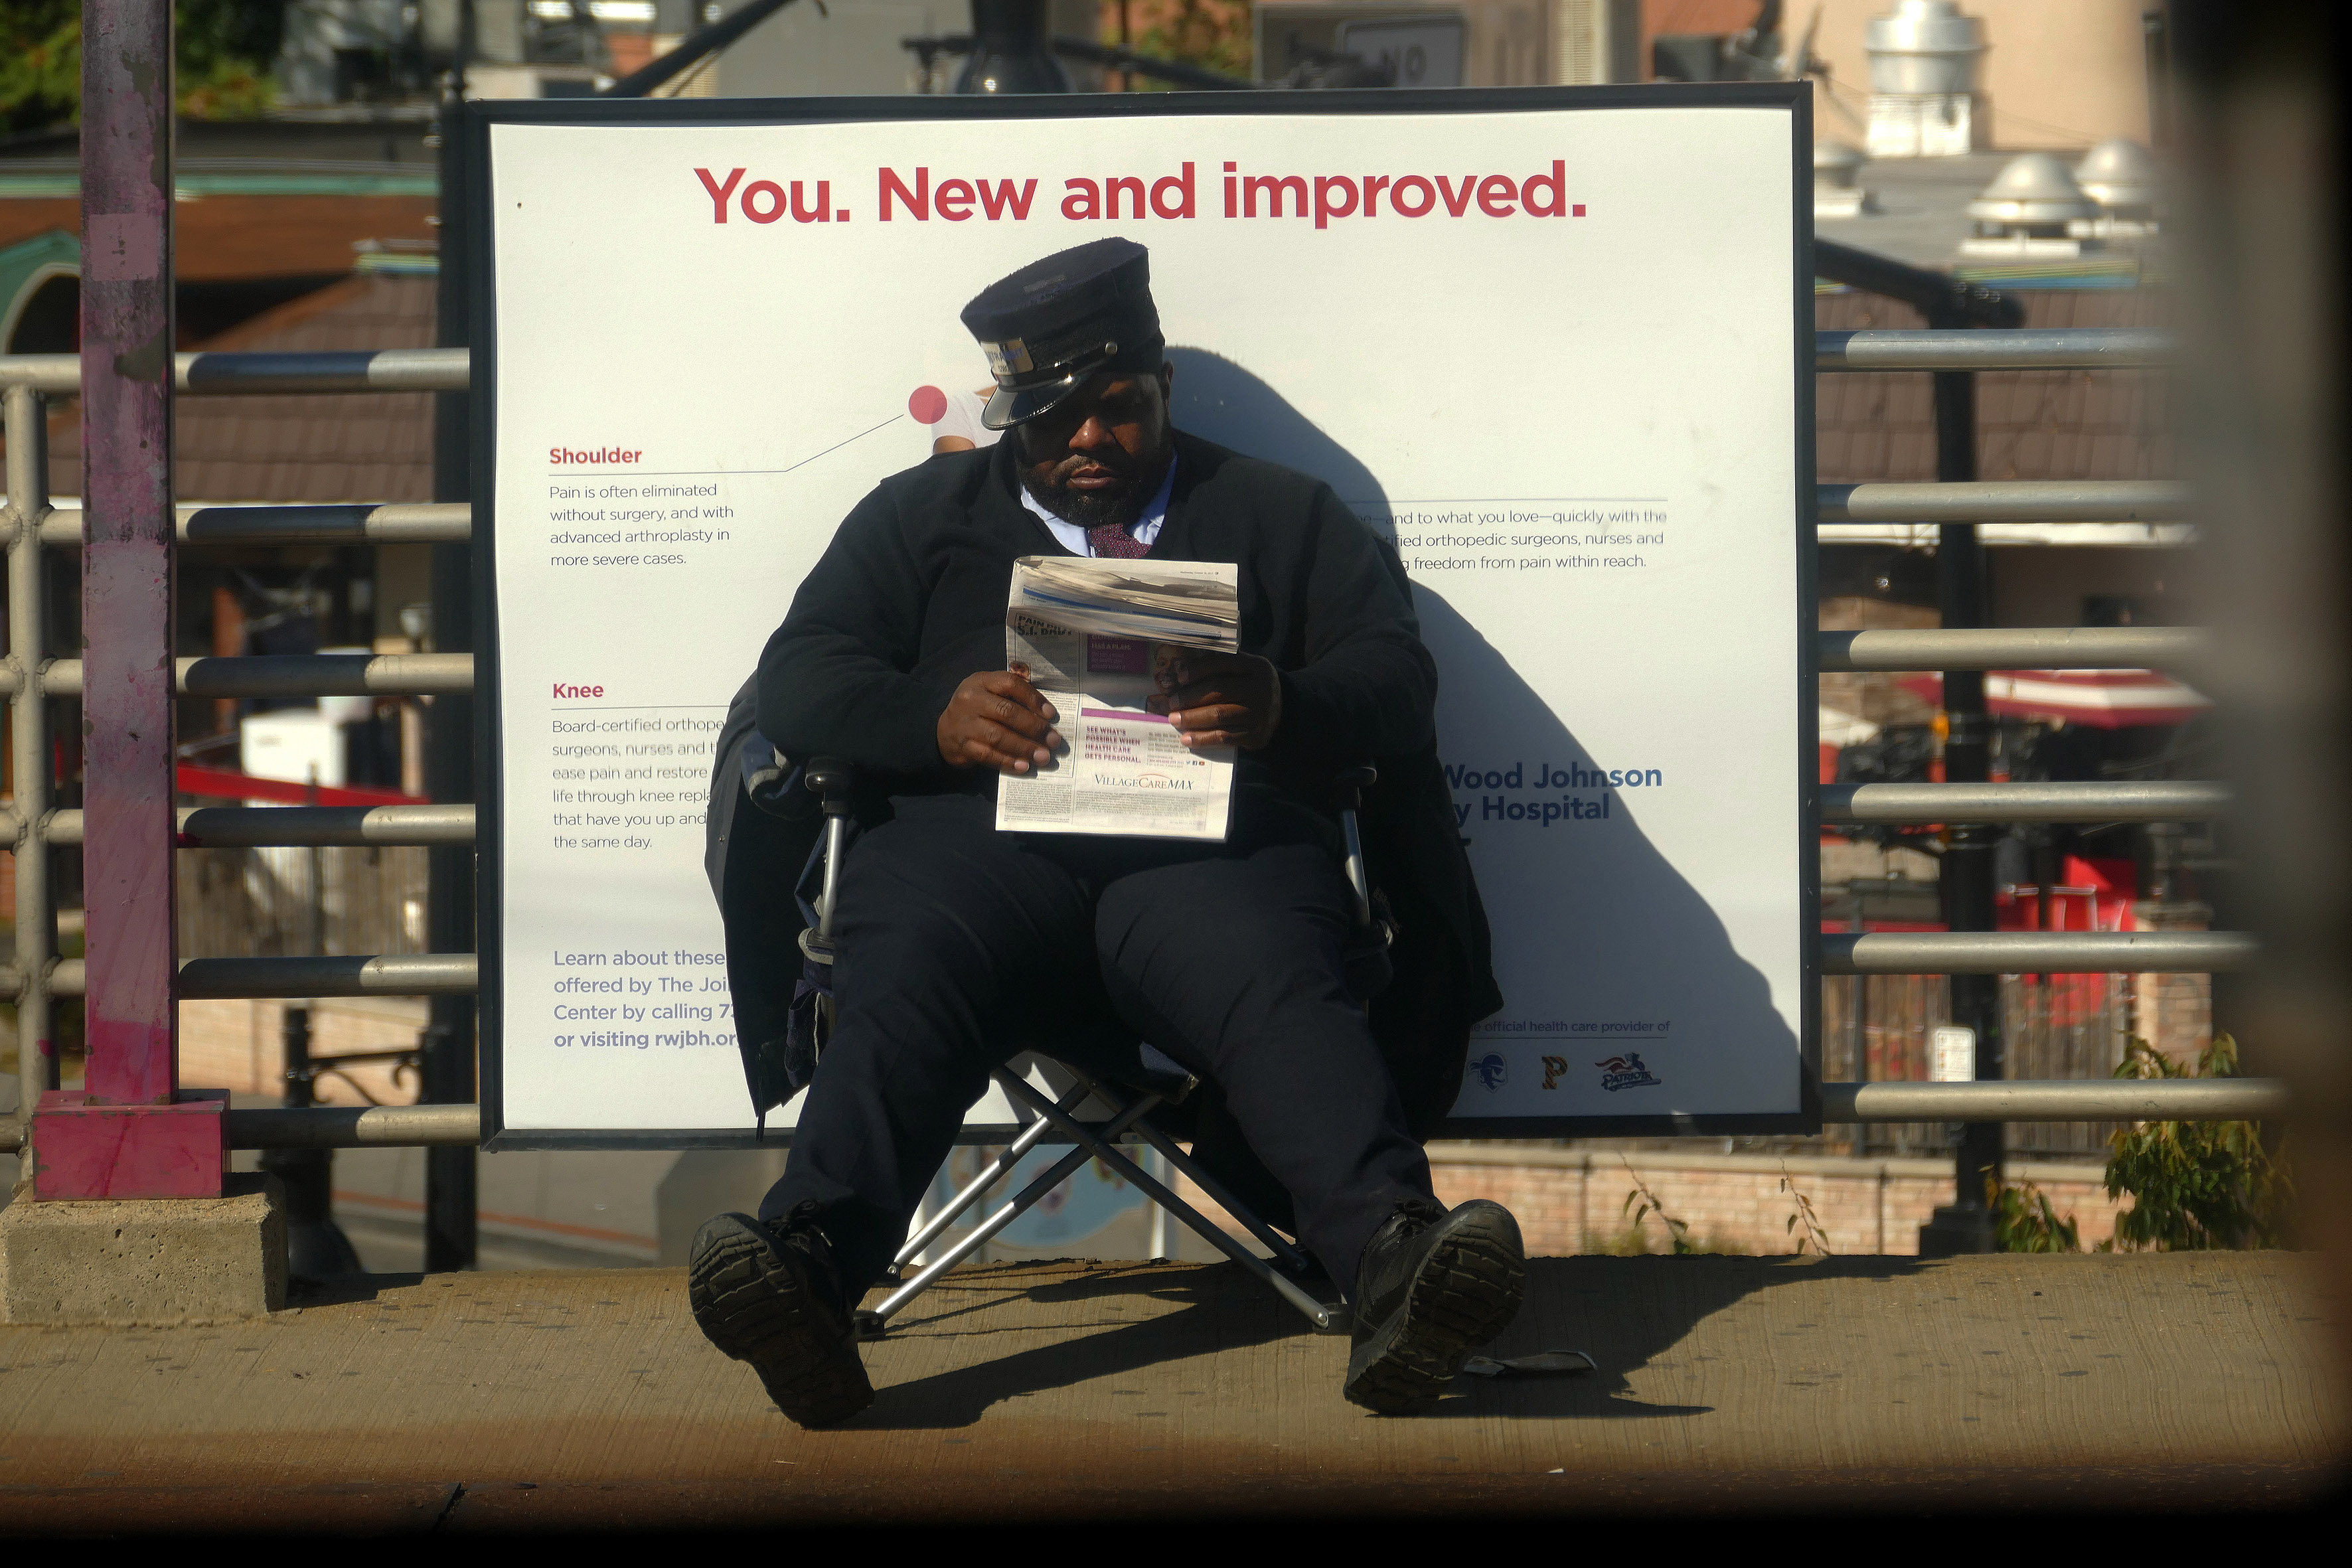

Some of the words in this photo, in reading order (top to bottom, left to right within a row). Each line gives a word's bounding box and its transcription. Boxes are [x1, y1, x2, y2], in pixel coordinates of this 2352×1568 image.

[694, 167, 850, 224] You.
[878, 167, 1038, 222] New
[1061, 162, 1195, 220] and
[1224, 159, 1587, 229] improved.
[550, 447, 643, 464] Shoulder
[550, 486, 580, 499] Pain
[585, 486, 595, 499] is
[599, 485, 637, 498] often
[643, 484, 717, 497] eliminated
[550, 509, 605, 521] without
[610, 509, 666, 522] surgery,
[671, 507, 698, 519] and
[702, 505, 734, 518] with
[1418, 512, 1432, 524] to
[1437, 511, 1473, 524] what
[1478, 512, 1504, 527] you
[1609, 509, 1639, 524] with
[1644, 510, 1666, 523] the
[550, 530, 620, 544] advanced
[625, 528, 712, 544] arthroplasty
[718, 528, 730, 540] in
[1426, 533, 1507, 549] orthopedic
[1511, 534, 1581, 548] surgeons,
[1586, 533, 1632, 545] nurses
[1637, 532, 1664, 544] and
[551, 554, 588, 566] more
[593, 554, 639, 566] severe
[643, 552, 686, 565] cases.
[1414, 556, 1476, 570] freedom
[1481, 555, 1515, 568] from
[1520, 555, 1551, 571] pain
[1556, 555, 1599, 568] within
[1604, 555, 1646, 568] reach.
[553, 683, 603, 698] Knee
[552, 718, 661, 733] Board-certified
[666, 718, 725, 732] orthope
[1086, 734, 1117, 744] POSSIBLE
[552, 745, 621, 758] surgeons,
[625, 744, 672, 755] nurses
[678, 742, 704, 755] and
[1085, 744, 1111, 752] HEALTH
[1104, 754, 1141, 763] PERSONAL.
[552, 767, 585, 779] ease
[589, 766, 619, 782] pain
[625, 766, 651, 779] and
[657, 767, 707, 778] restore
[1444, 762, 1522, 789] Wood
[1533, 761, 1662, 789] Johnson
[554, 789, 573, 803] life
[578, 789, 634, 805] through
[639, 789, 674, 802] knee
[679, 789, 712, 804] repla
[1482, 793, 1610, 827] Hospital
[554, 813, 582, 826] that
[586, 813, 619, 825] have
[625, 815, 651, 827] you
[656, 815, 674, 827] up
[679, 812, 706, 824] and
[554, 836, 577, 848] the
[582, 837, 619, 848] same
[624, 835, 653, 849] day.
[554, 951, 607, 966] Learn
[612, 950, 668, 965] about
[674, 950, 725, 965] these
[554, 977, 622, 993] offered
[630, 977, 651, 995] by
[659, 977, 693, 992] The
[699, 977, 730, 992] Joi
[554, 1004, 616, 1020] Center
[623, 1004, 645, 1022] by
[652, 1003, 712, 1021] calling
[1485, 1021, 1526, 1032] official
[1529, 1021, 1567, 1032] health
[1572, 1022, 1597, 1032] care
[1601, 1020, 1654, 1033] provider
[1658, 1020, 1670, 1031] of
[554, 1034, 574, 1048] or
[580, 1031, 649, 1050] visiting
[656, 1030, 738, 1048] rwjbh.or
